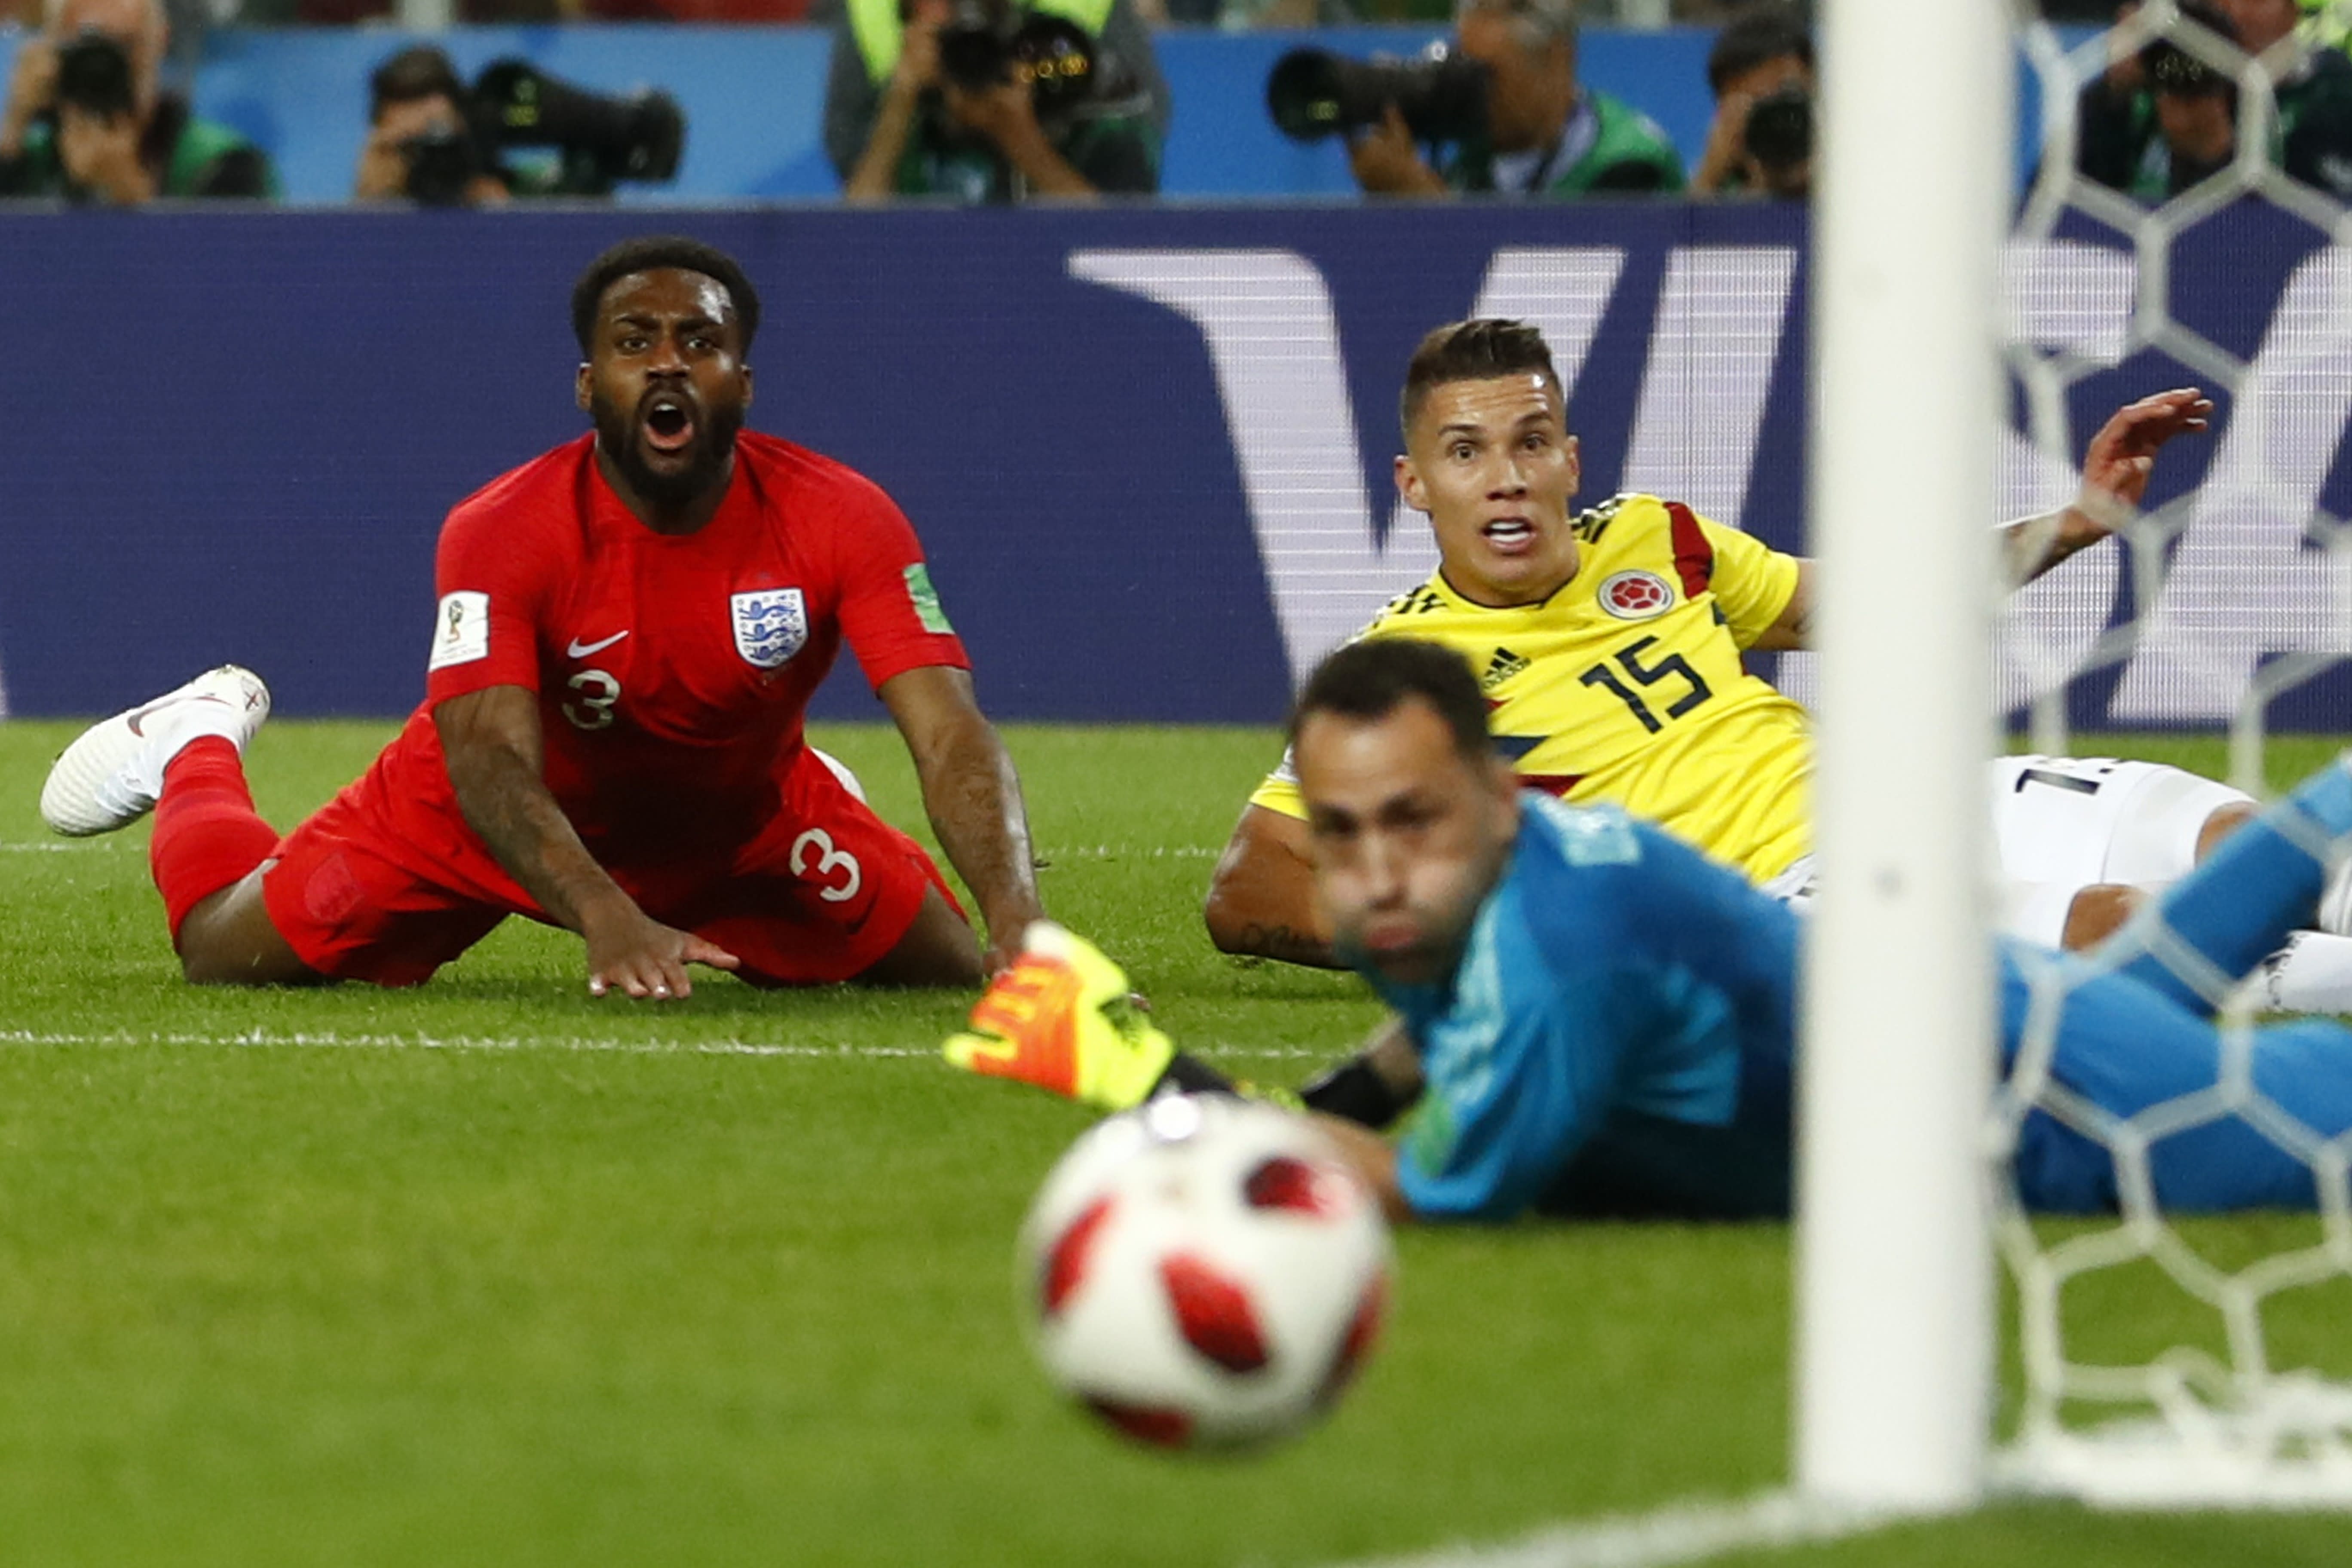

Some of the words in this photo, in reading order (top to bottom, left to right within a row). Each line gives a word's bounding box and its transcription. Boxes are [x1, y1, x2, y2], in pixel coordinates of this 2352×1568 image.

[562, 669, 621, 730] 3
[1578, 635, 1713, 734] 15
[790, 827, 861, 902] 3
